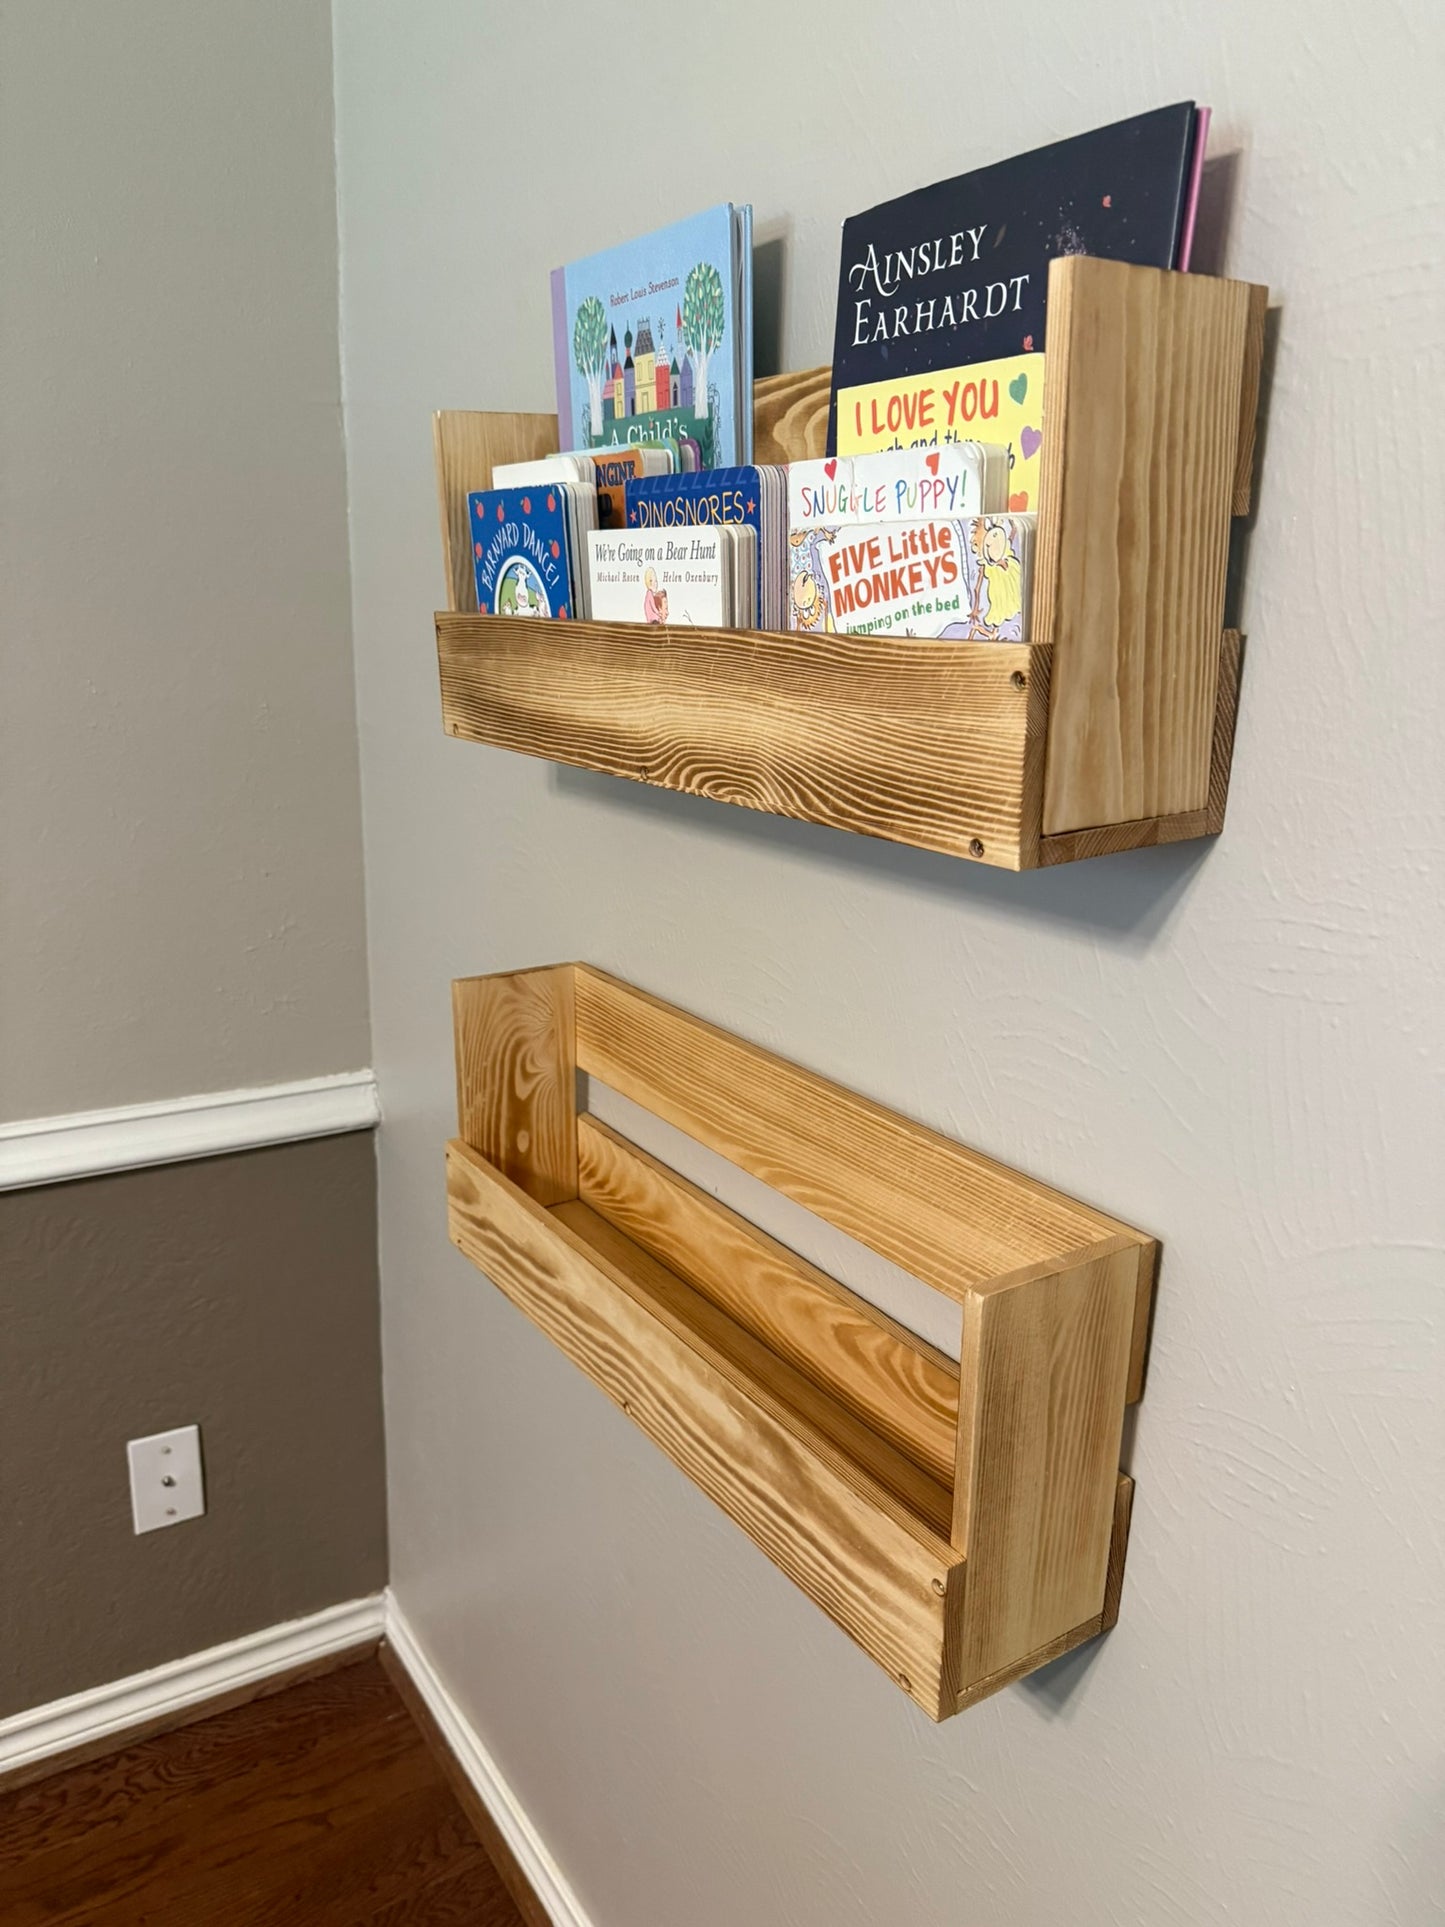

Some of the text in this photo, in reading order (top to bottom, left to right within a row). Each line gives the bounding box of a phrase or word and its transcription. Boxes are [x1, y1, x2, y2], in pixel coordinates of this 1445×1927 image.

[849, 224, 988, 297] AINSLEY
[609, 277, 679, 307] Robert Louis Stevenson
[851, 274, 1030, 347] EARHARDT
[855, 378, 999, 437] I LOVE YOU
[610, 417, 689, 447] A Child's
[596, 460, 637, 487] NGINE
[895, 470, 967, 514] PUPPY!
[637, 490, 745, 528] DINOSNORES
[481, 522, 560, 592] BARNYARD DANCE!
[595, 540, 716, 567] We're Going on a Bear Hunt
[828, 522, 952, 584] FIVE Little
[597, 571, 719, 586] Michael Rosen Helen Oxenbury
[832, 550, 958, 618] MONKEYS
[846, 594, 960, 635] jumping on the bed
